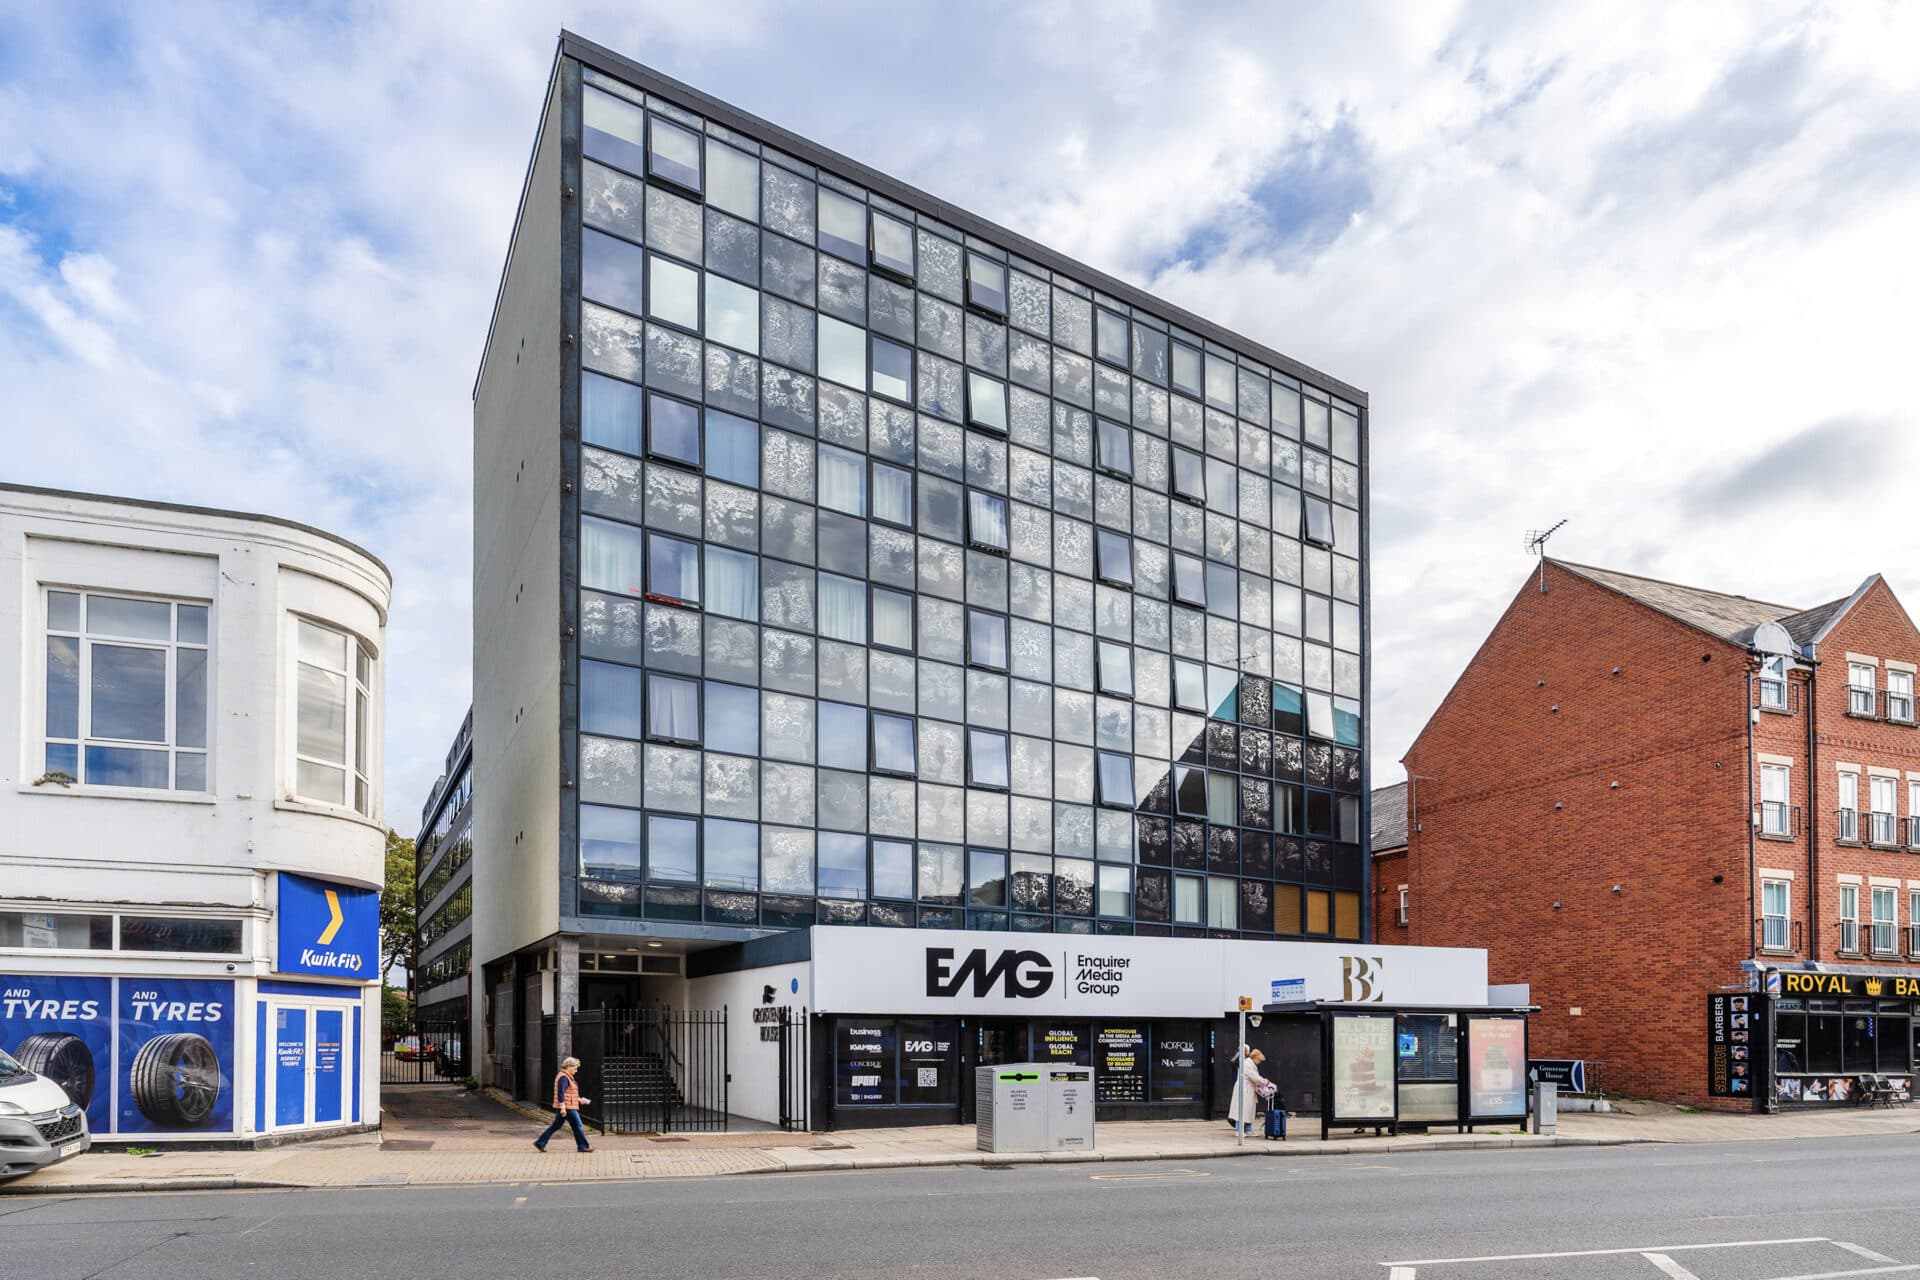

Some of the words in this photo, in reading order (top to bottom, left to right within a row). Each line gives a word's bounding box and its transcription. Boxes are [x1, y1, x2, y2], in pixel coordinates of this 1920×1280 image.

[1077, 954, 1130, 969] Enquirer
[926, 947, 1054, 998] EMG
[1075, 970, 1122, 981] Media
[1077, 982, 1120, 997] Group
[1786, 974, 1852, 993] ROYAL
[1895, 978, 1920, 996] BA
[3, 989, 31, 998] AND
[132, 991, 158, 1000] AND
[3, 999, 99, 1020] TYRES
[131, 1001, 223, 1022] TYRES
[1714, 996, 1724, 1042] BARBERS
[905, 1041, 933, 1052] EMG
[1160, 1041, 1194, 1050] NORFOLK
